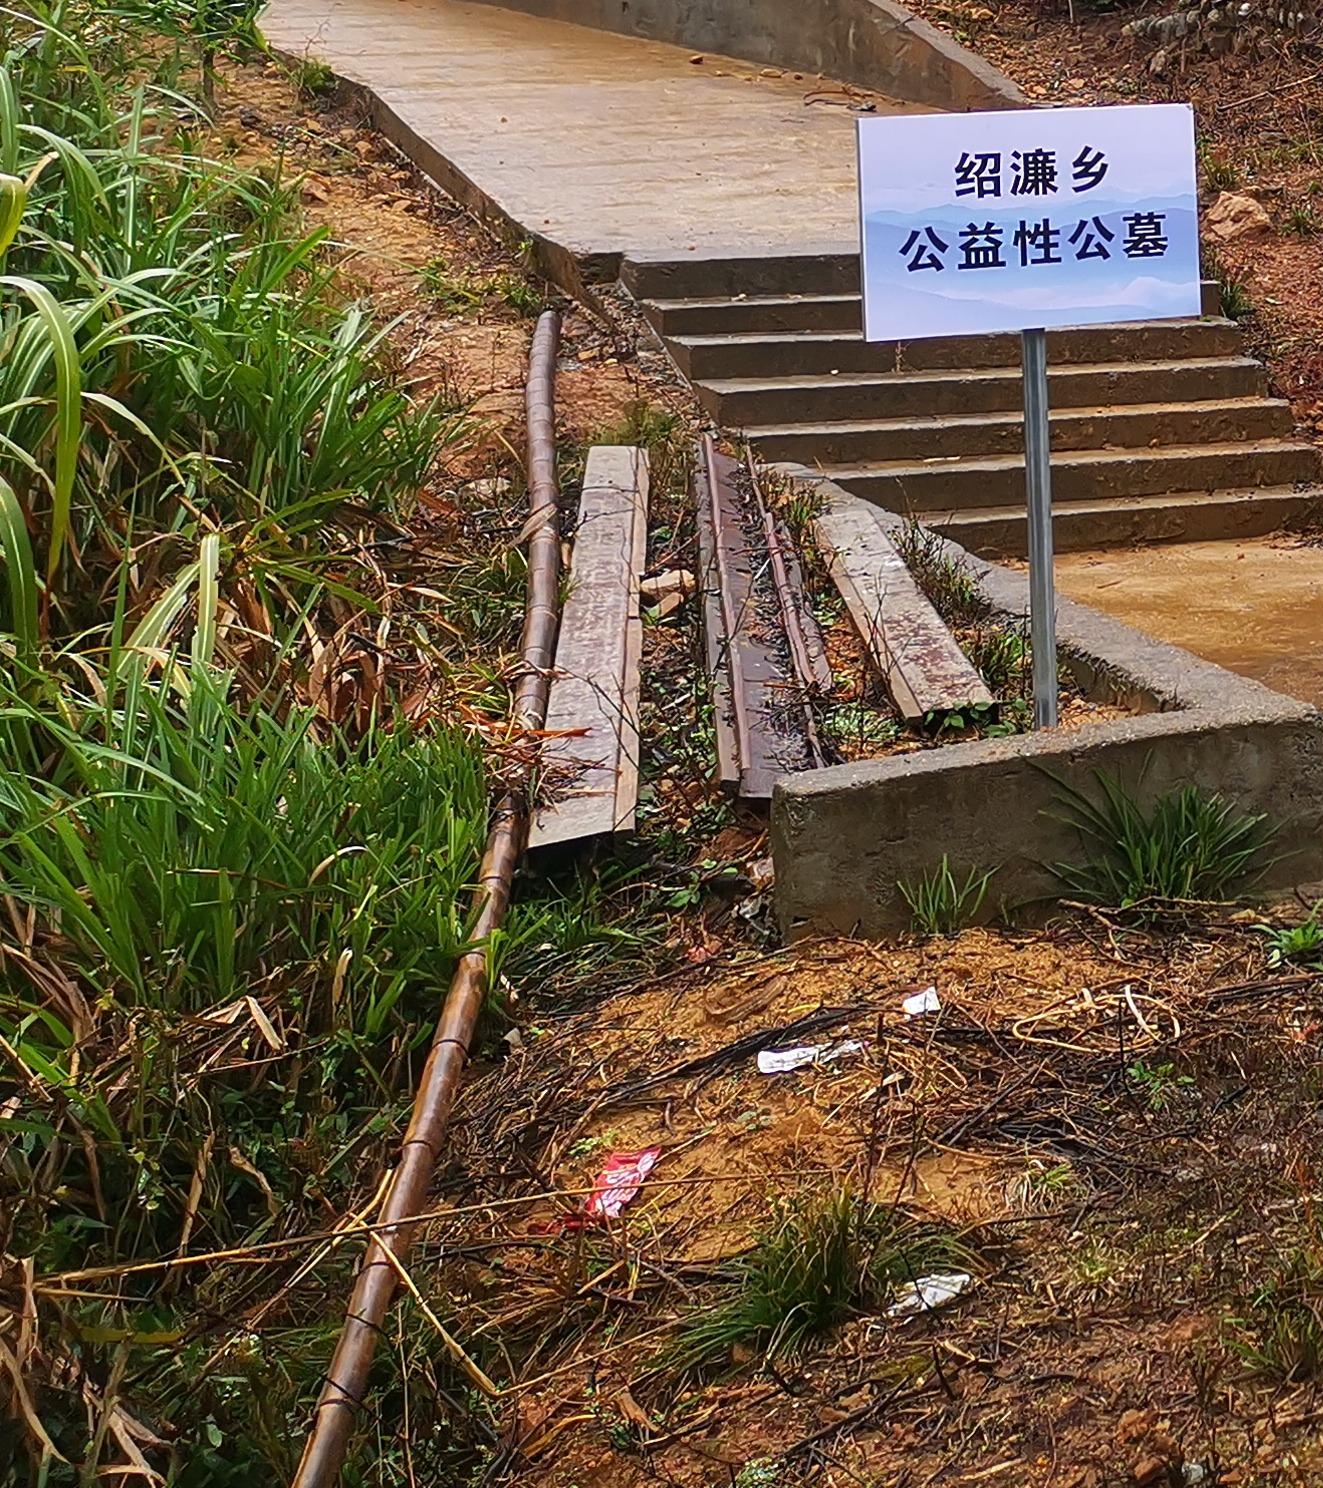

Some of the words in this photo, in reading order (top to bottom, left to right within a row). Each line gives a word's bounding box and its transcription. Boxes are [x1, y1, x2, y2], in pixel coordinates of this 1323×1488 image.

[955, 146, 1109, 199] 绍濂乡
[899, 211, 1168, 273] 公益性公墓
